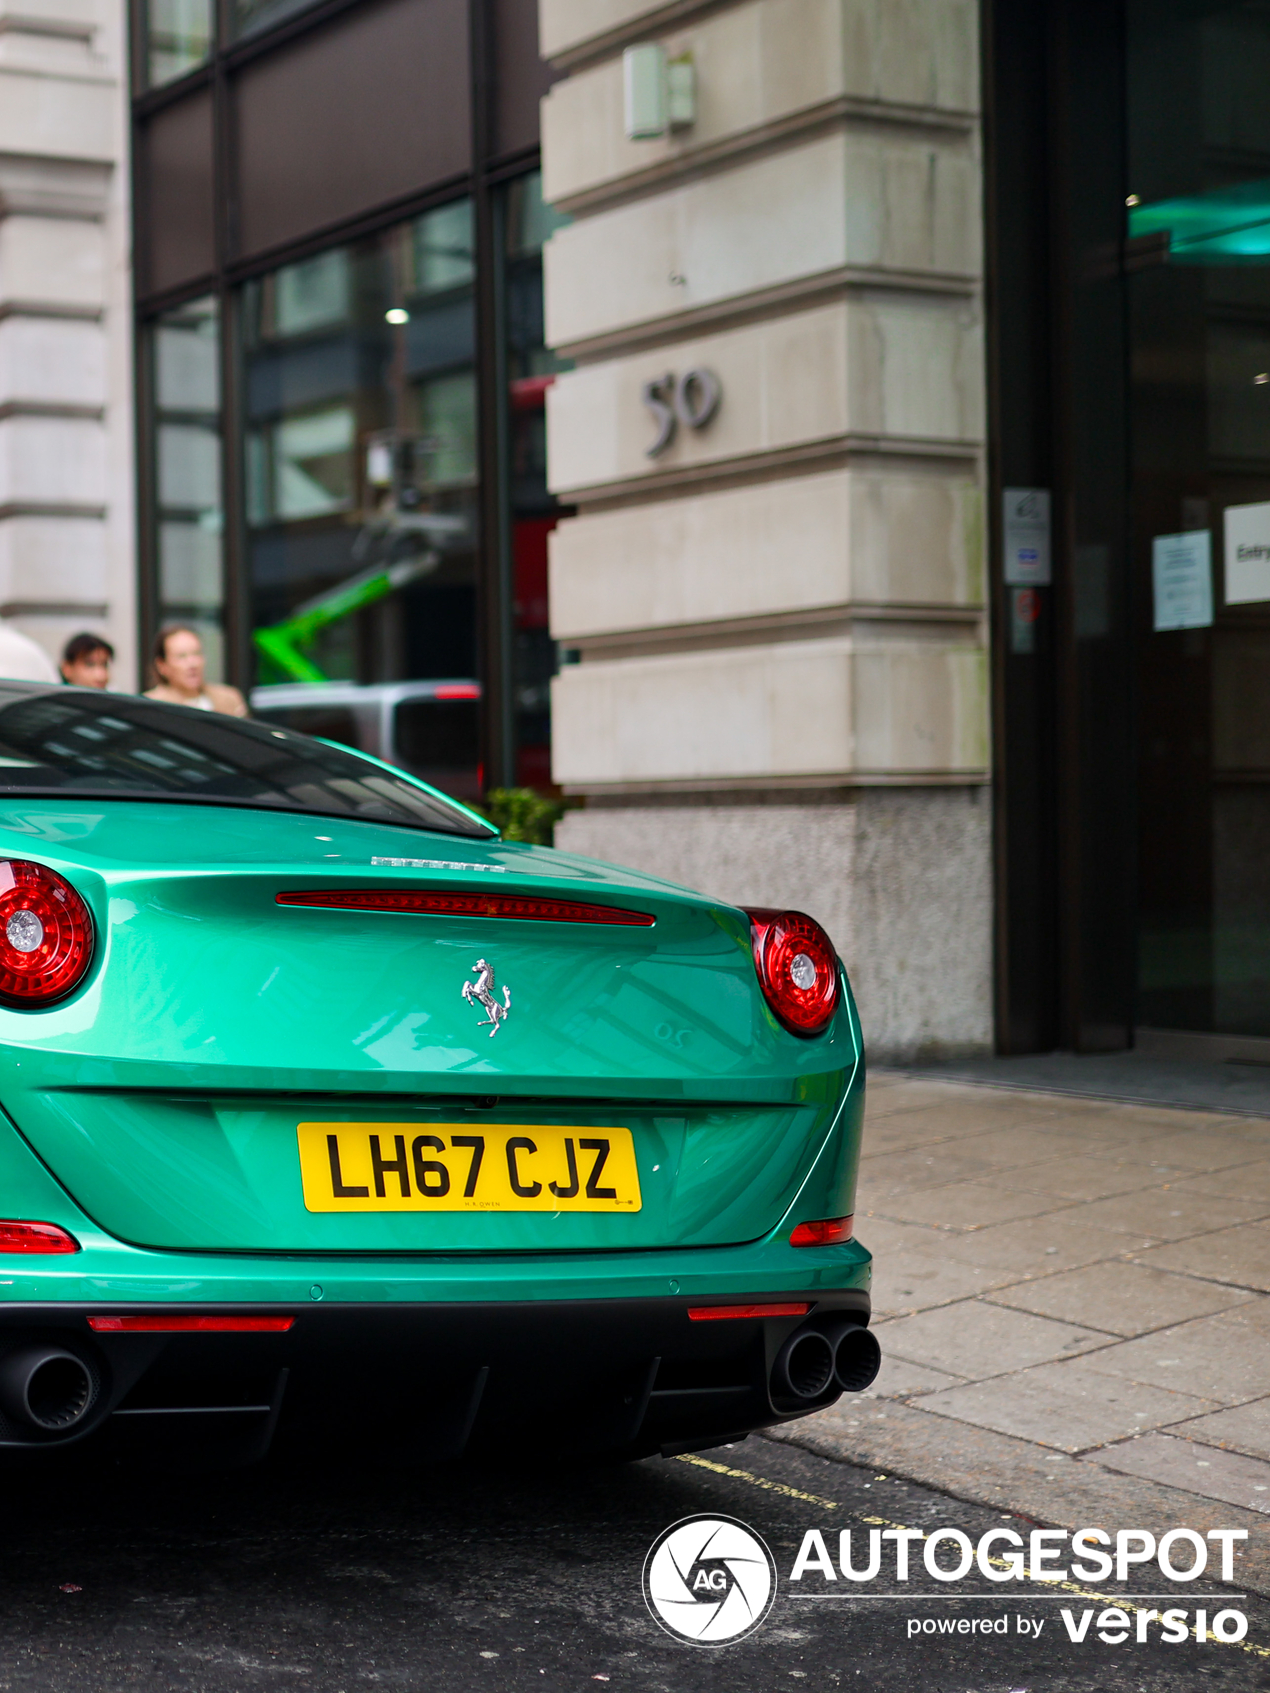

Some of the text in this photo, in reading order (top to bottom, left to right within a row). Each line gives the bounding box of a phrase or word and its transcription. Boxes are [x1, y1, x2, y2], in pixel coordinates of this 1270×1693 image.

[644, 370, 721, 457] 50
[326, 1134, 617, 1199] LH67 CJZ
